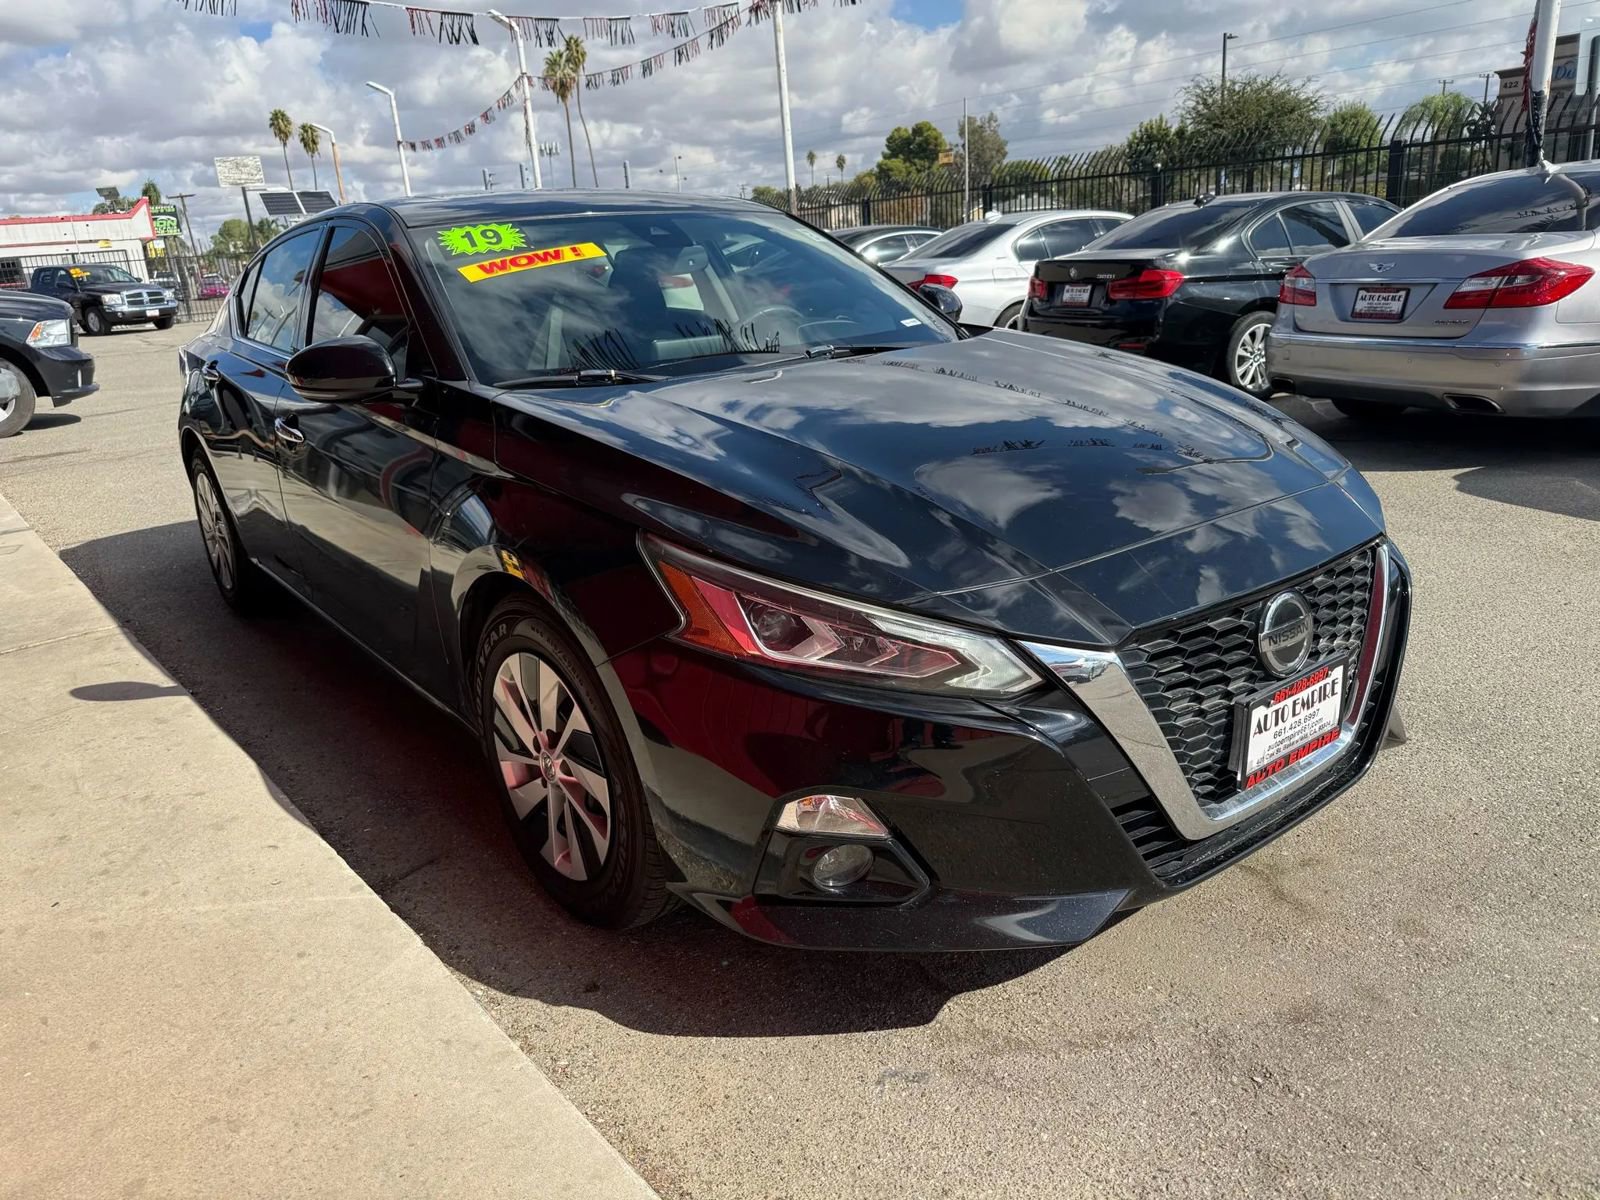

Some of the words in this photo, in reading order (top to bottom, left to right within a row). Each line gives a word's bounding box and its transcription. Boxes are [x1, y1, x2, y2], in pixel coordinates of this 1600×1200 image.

[1503, 80, 1519, 89] 422
[460, 228, 503, 248] 19
[477, 249, 564, 275] WOW
[1377, 294, 1403, 302] EMPIRE
[1268, 620, 1308, 647] NISSAN
[1273, 667, 1330, 704] 661-428-6997
[1253, 703, 1290, 738] AUTO
[1292, 677, 1339, 718] EMPIRE
[1273, 708, 1321, 740] 661.428.6997
[1246, 758, 1286, 788] AUTO
[1288, 728, 1340, 765] EMPIRE
